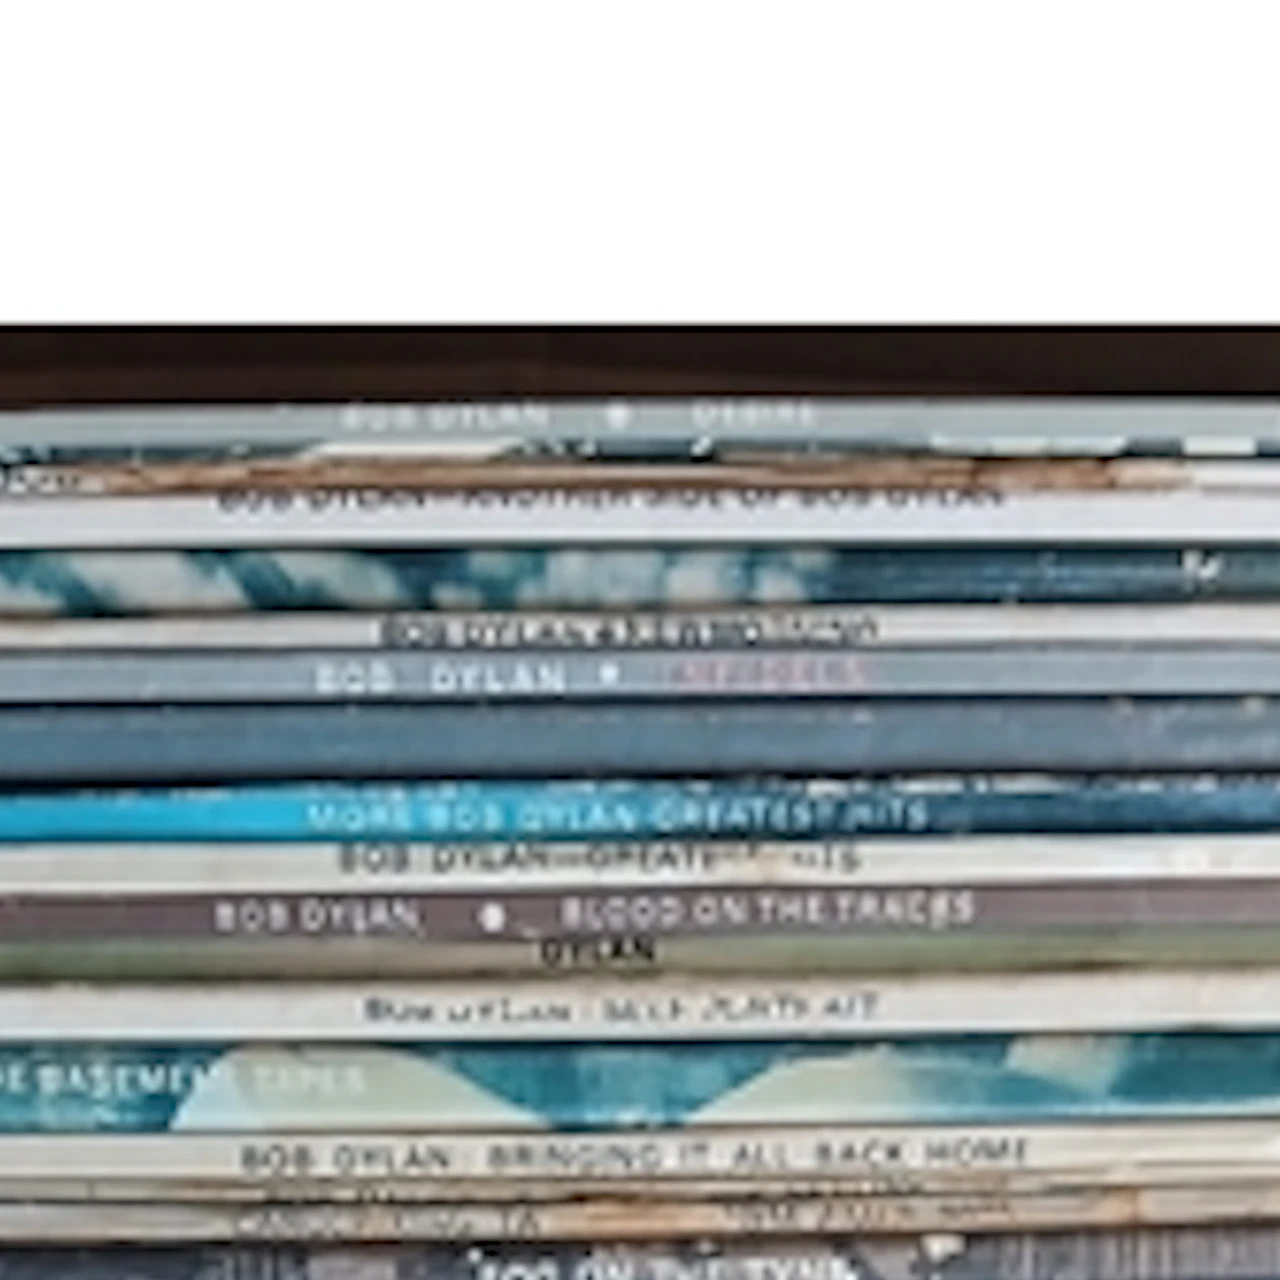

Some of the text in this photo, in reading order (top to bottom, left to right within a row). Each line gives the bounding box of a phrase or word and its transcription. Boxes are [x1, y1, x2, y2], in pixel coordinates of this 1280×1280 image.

[316, 662, 566, 693] BOB DYLAN
[215, 902, 290, 932] BOB
[301, 902, 420, 932] DYLAN
[561, 897, 678, 926] BLOOD
[332, 1143, 450, 1173] DYLAN
[488, 1141, 661, 1171] BRINGING
[815, 1138, 907, 1167] BACK
